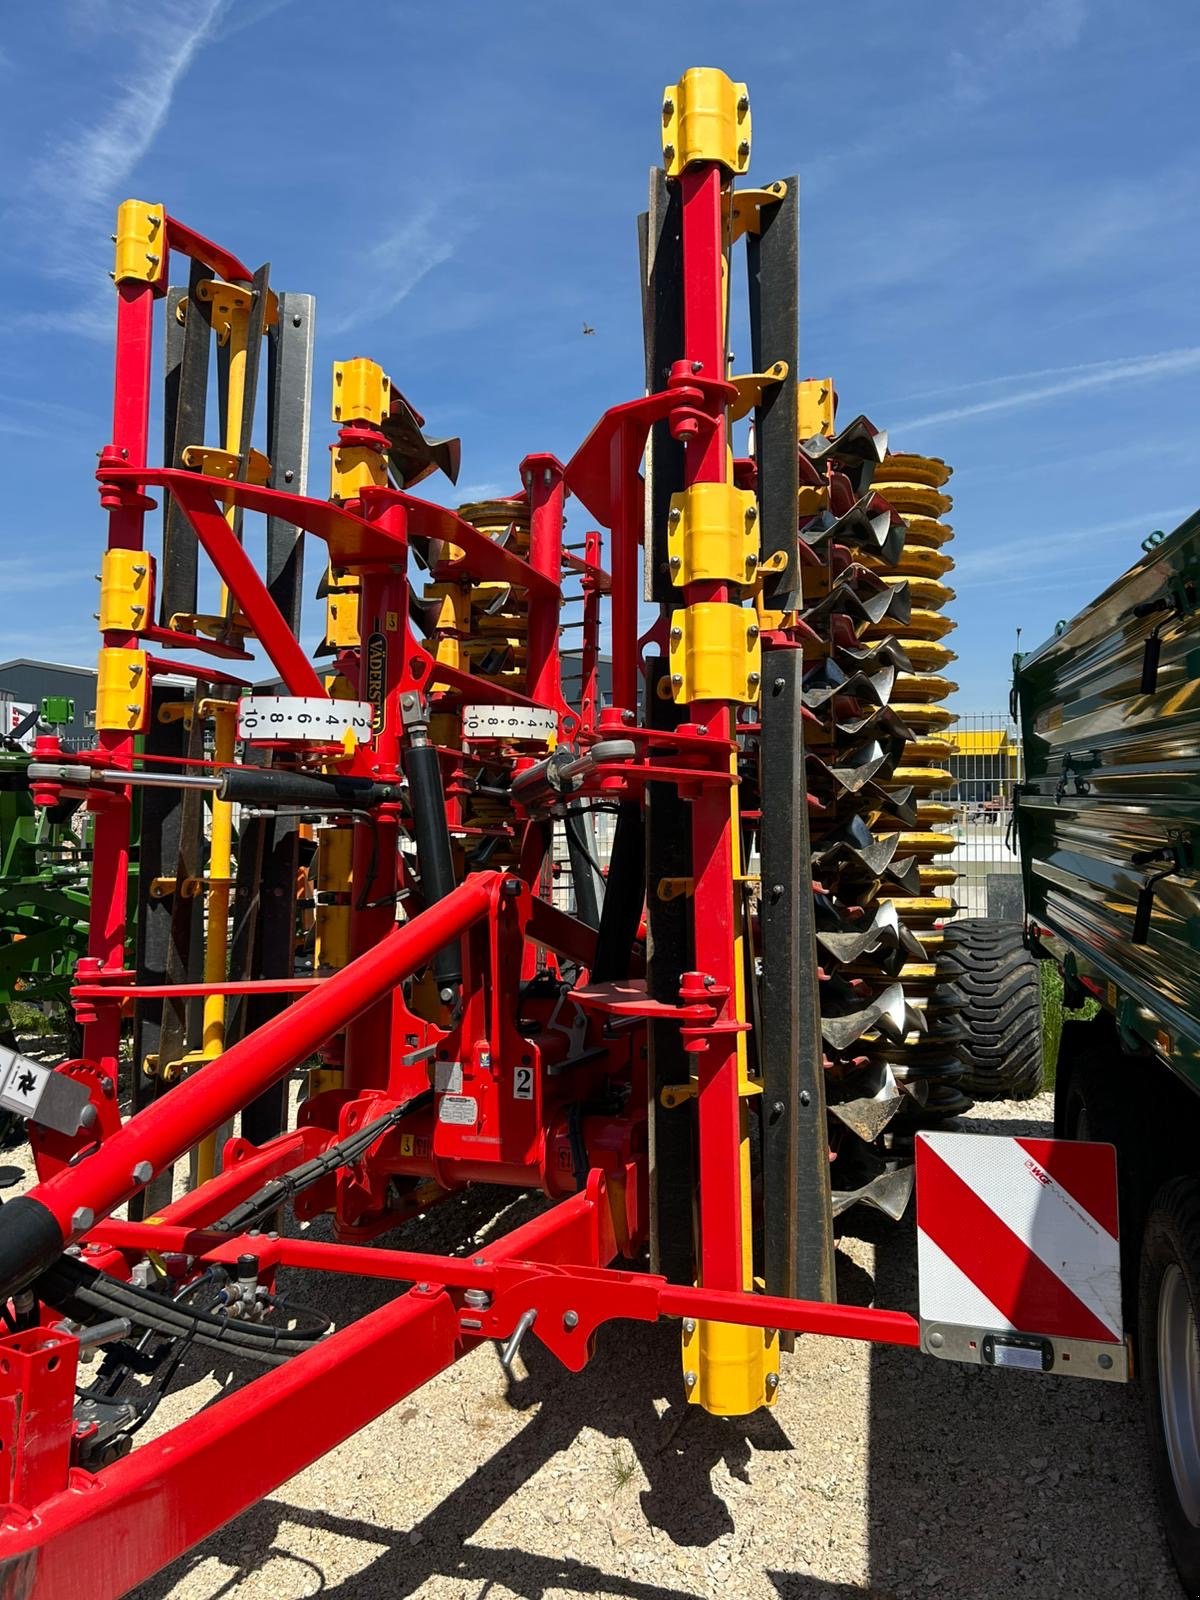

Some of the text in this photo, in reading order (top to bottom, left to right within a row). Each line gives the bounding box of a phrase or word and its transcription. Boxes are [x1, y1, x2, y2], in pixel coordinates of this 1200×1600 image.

[369, 640, 385, 729] VÄDERSTD
[245, 709, 258, 728] 10
[270, 713, 284, 723] 8
[298, 713, 312, 723] 6
[326, 715, 339, 725] 4
[353, 717, 366, 727] 2
[468, 714, 479, 729] 10
[488, 717, 499, 725] 8
[508, 718, 518, 726] 6
[528, 719, 538, 727] 4
[545, 721, 554, 729] 2
[517, 1069, 531, 1093] 2
